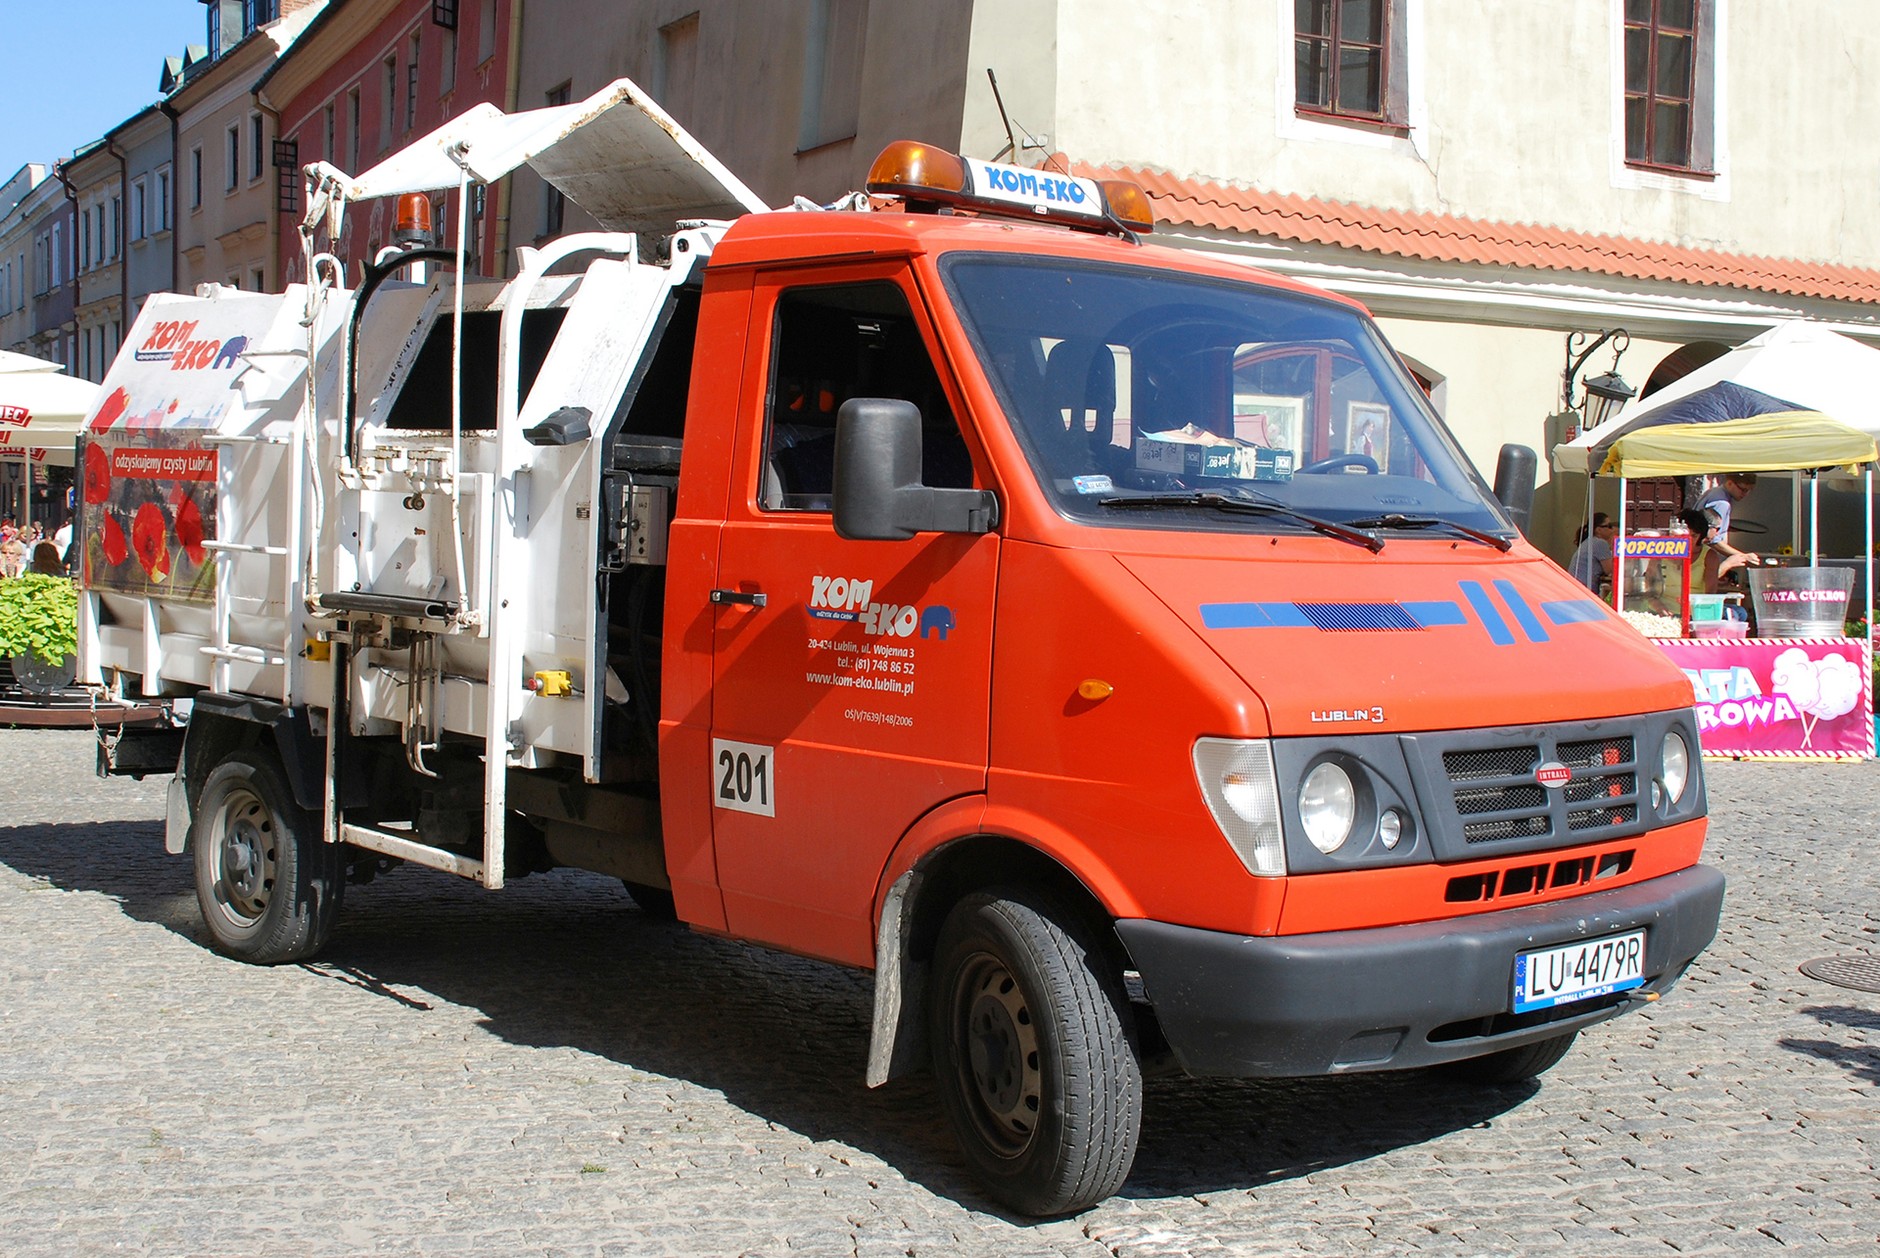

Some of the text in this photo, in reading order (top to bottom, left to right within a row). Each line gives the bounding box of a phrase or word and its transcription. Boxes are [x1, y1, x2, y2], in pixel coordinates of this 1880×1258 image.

[984, 166, 1086, 204] KOM-EKO
[142, 320, 199, 350] KOM
[170, 339, 221, 370] EKO
[115, 453, 213, 475] odzyskujemy czysty Lublin
[810, 575, 873, 611] KOM
[1762, 591, 1797, 602] WATA
[859, 602, 918, 638] EKO
[808, 638, 915, 659] 20-424 Lublin, ul. Wojenna 3
[837, 657, 915, 675] tel.: (81) 748 86 52
[806, 672, 914, 697] www.kom-eko.lublin.pl
[1311, 706, 1384, 723] LUBLIN 3
[719, 749, 767, 806] 201
[1539, 770, 1568, 780] INTRALL
[1532, 937, 1640, 997] LU 4479R
[1515, 985, 1524, 998] PL
